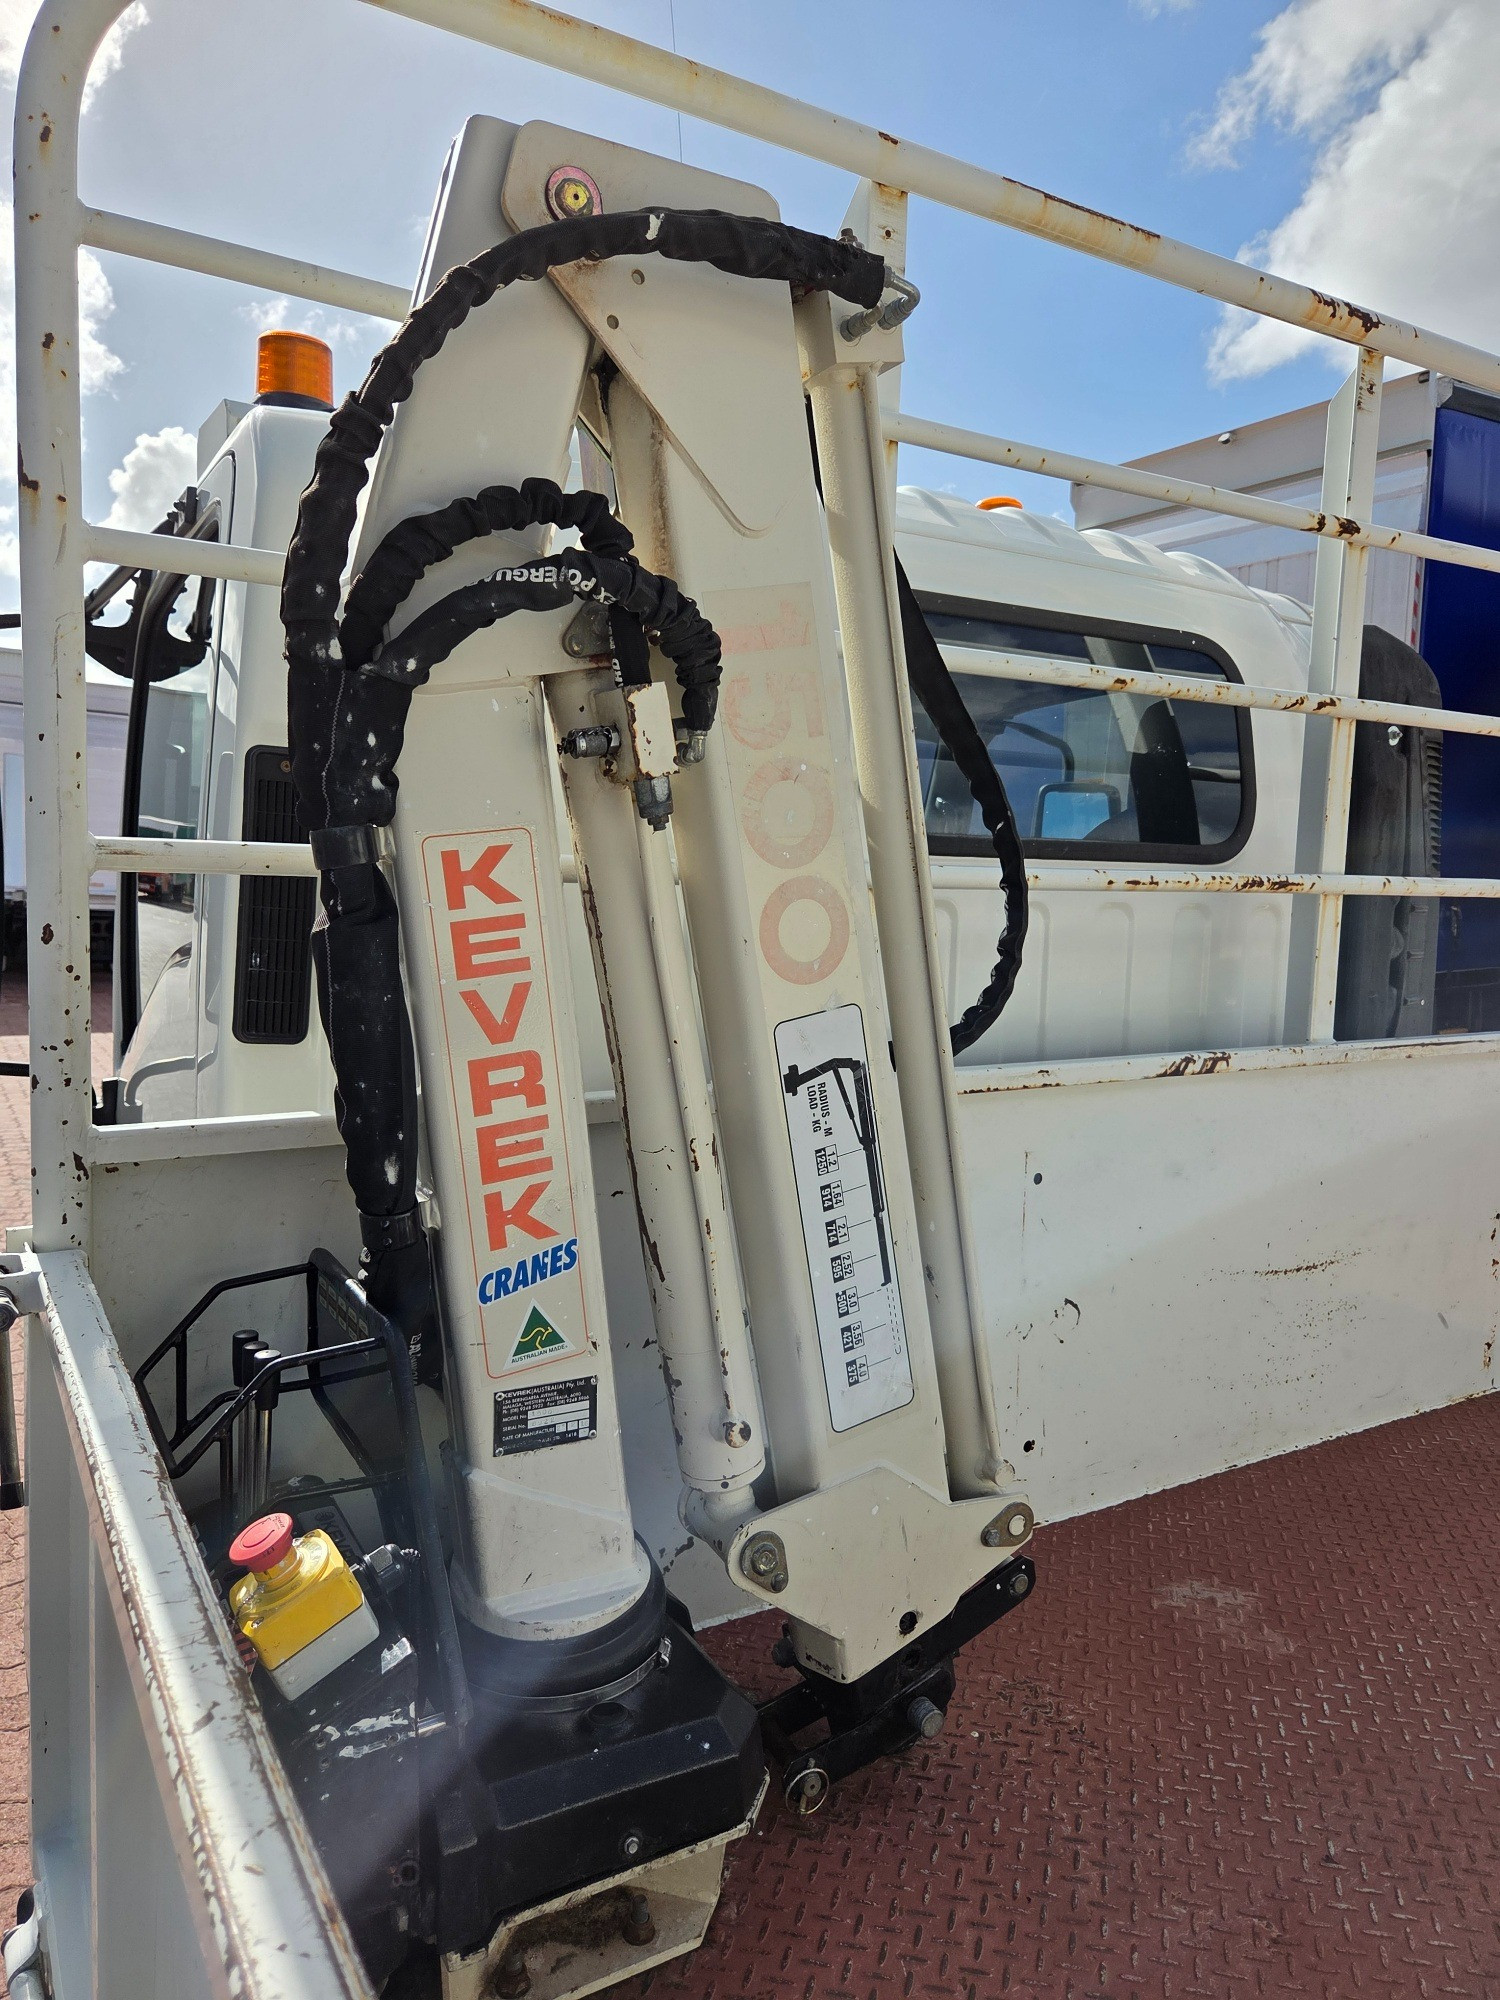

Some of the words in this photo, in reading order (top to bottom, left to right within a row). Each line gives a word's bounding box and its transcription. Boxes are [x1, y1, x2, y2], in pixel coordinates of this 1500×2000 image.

[717, 599, 850, 986] 1500
[440, 843, 561, 1252] KEVREK
[806, 1084, 818, 1110] LOAD
[817, 1081, 830, 1118] RADIUS
[811, 1119, 822, 1133] KG
[824, 1126, 833, 1137] M
[816, 1149, 828, 1174] 1250
[827, 1150, 837, 1167] 1.2
[821, 1187, 832, 1208] 914
[832, 1183, 843, 1205] 1.64
[826, 1223, 838, 1243] 714
[837, 1223, 847, 1238] 2.1
[478, 1238, 578, 1305] CRANES
[832, 1259, 842, 1279] 595
[842, 1254, 853, 1276] 2.52
[837, 1296, 848, 1314] 500
[847, 1292, 857, 1309] 3.0
[842, 1330, 853, 1349] 421
[852, 1324, 863, 1346] 3.56
[511, 1349, 548, 1364] AUSTRALIAN
[848, 1364, 858, 1383] 375
[858, 1362, 867, 1378] 4.0
[522, 1428, 555, 1437] MANUFACTURE
